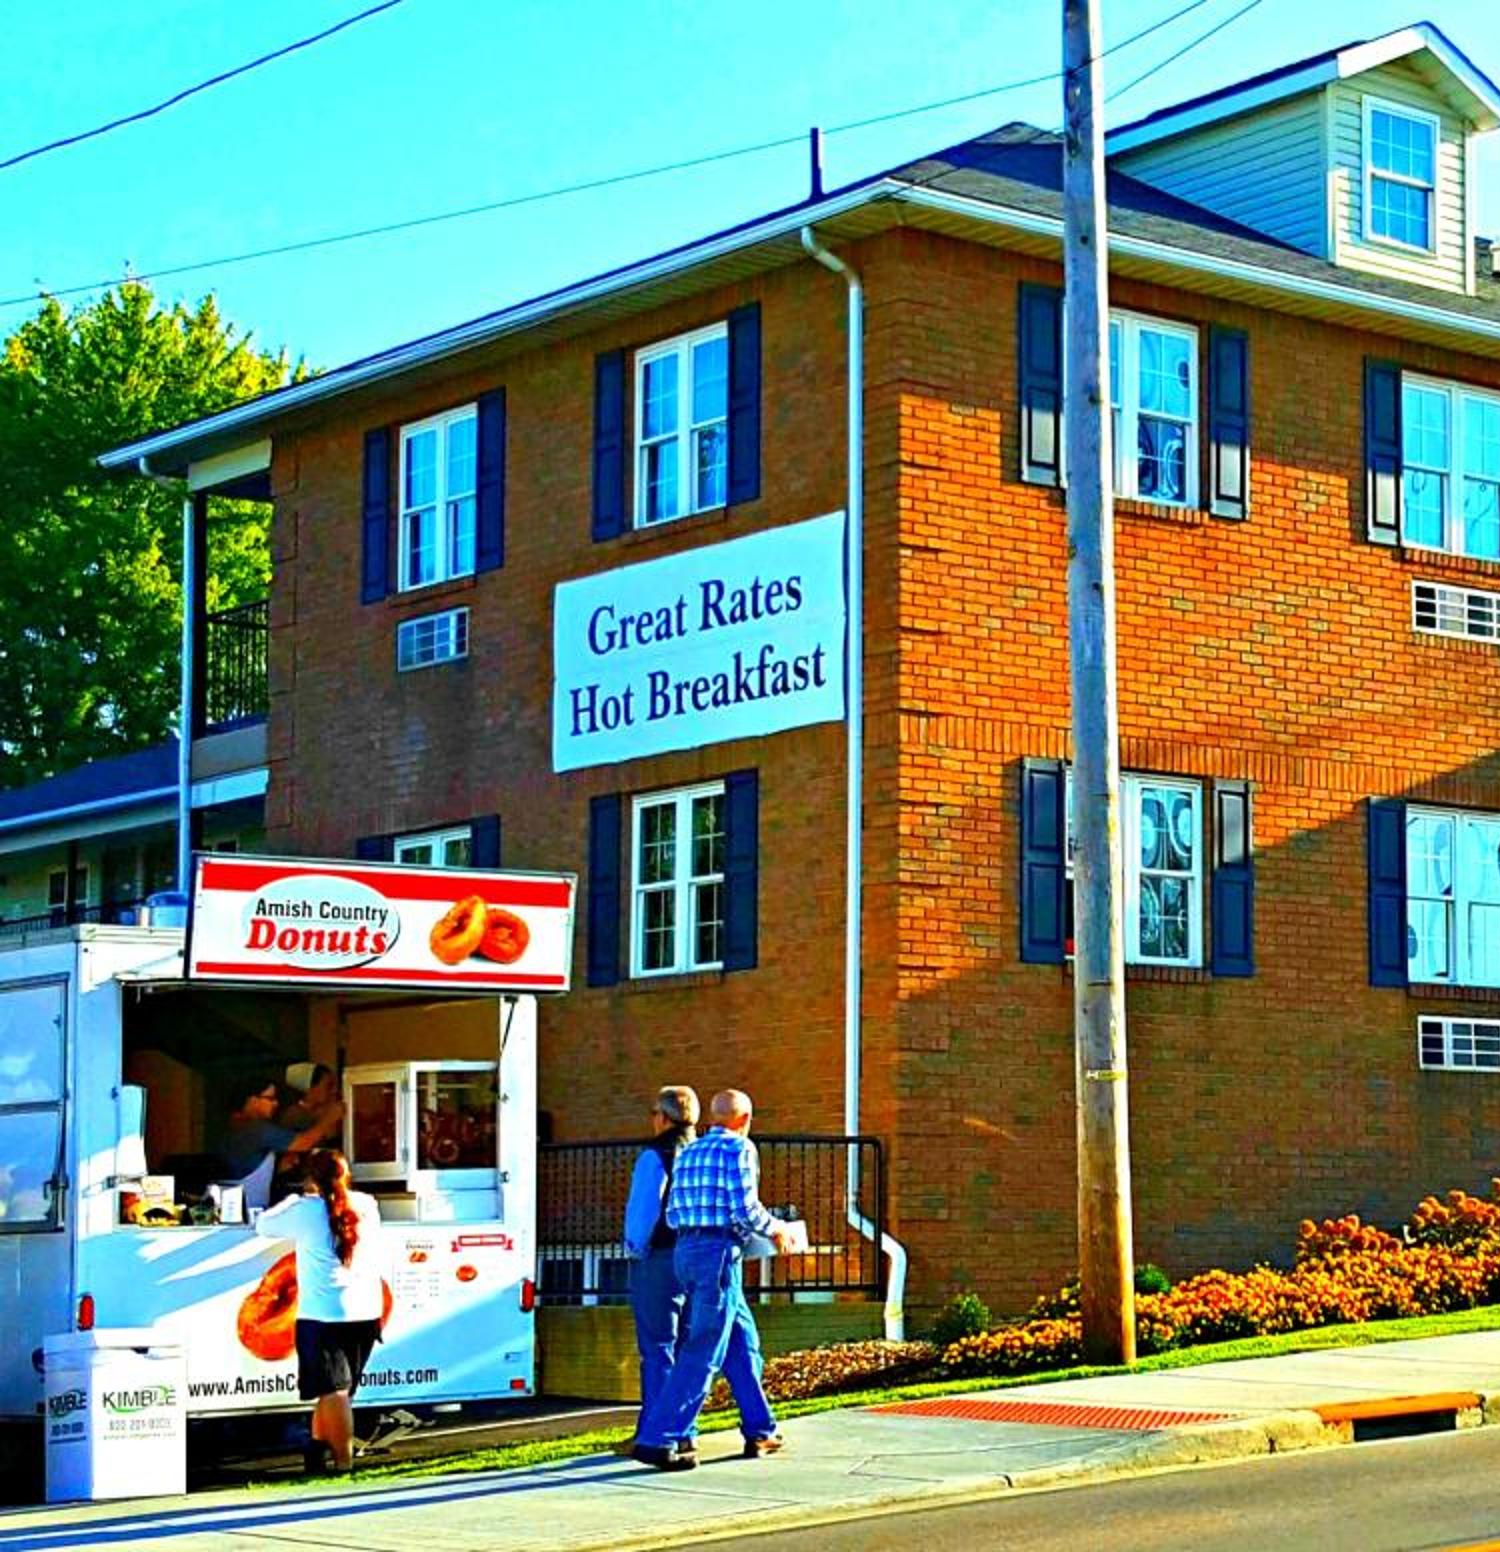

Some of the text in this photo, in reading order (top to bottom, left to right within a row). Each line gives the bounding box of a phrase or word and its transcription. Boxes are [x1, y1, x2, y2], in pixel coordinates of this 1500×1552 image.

[587, 575, 802, 655] Great Rates
[570, 642, 827, 737] Hot Breakfast
[243, 918, 391, 956] Donuts
[255, 898, 389, 928] Amish Country
